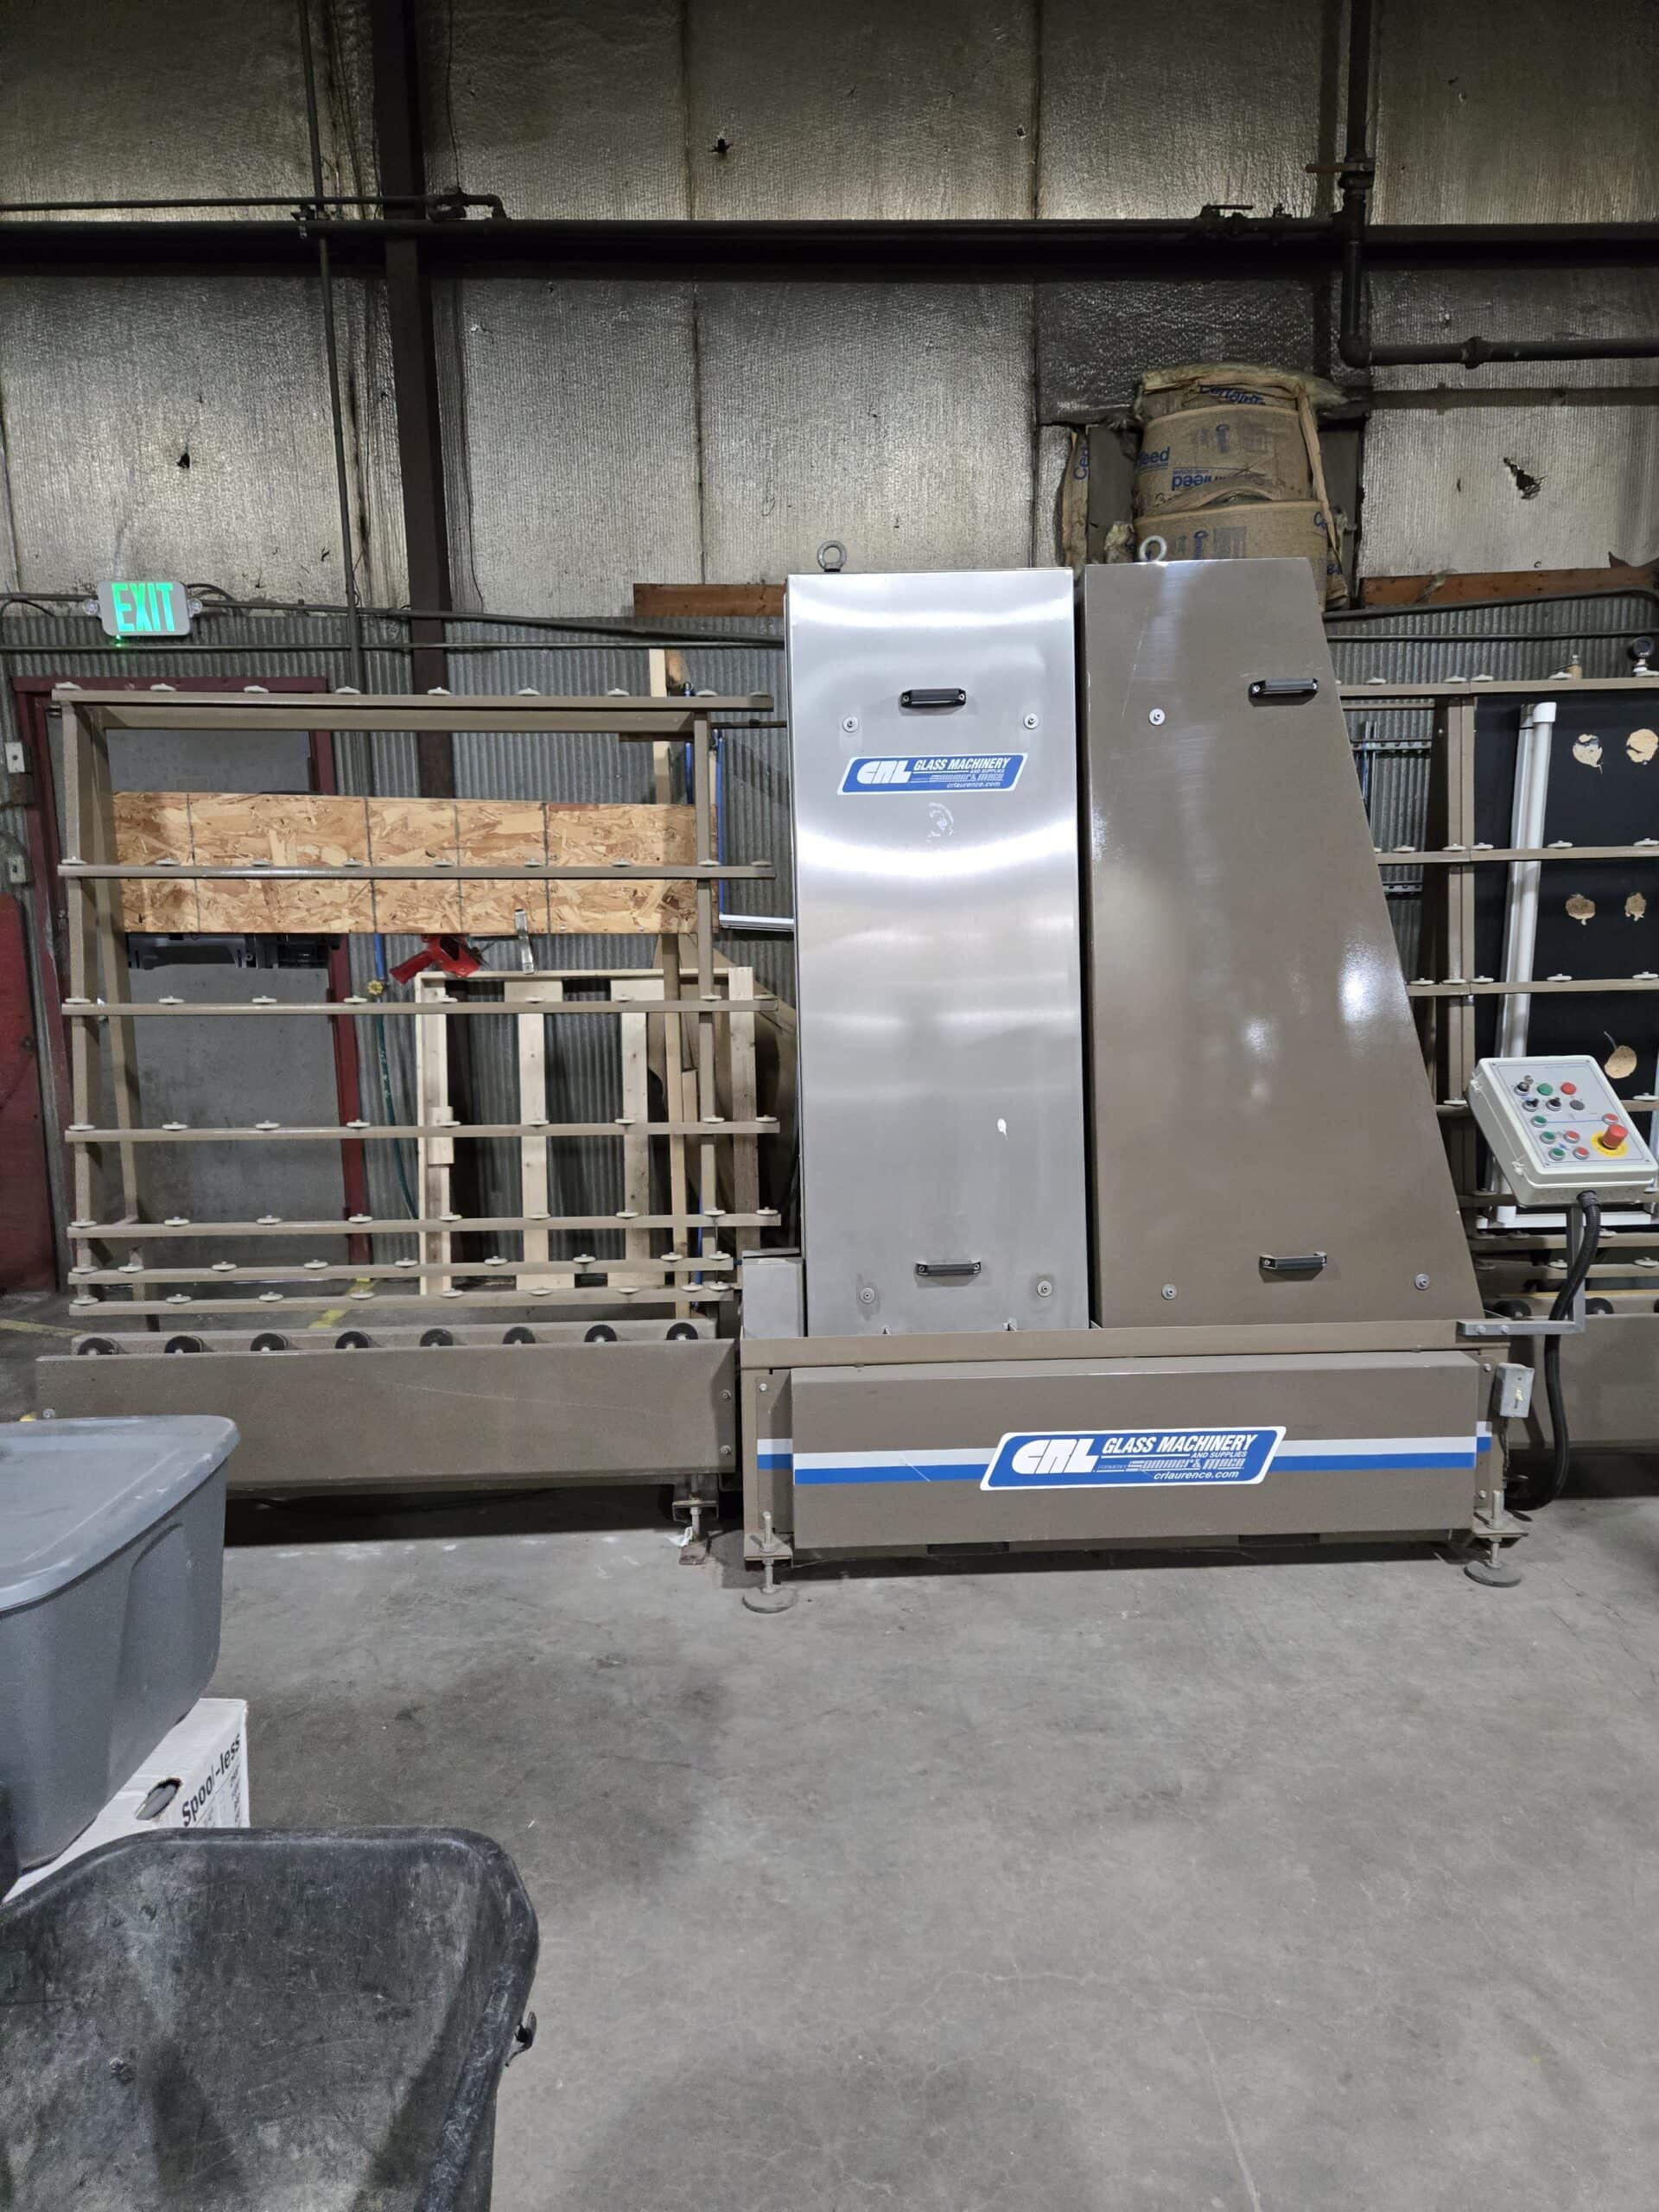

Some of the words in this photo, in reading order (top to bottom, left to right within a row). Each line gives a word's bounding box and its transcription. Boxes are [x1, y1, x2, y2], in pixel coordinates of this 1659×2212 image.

[111, 582, 175, 632] EXIT
[856, 760, 912, 785] CRL
[913, 759, 948, 771] GLASS
[948, 757, 1011, 770] MACHINERY
[1103, 1436, 1156, 1453] GLASS
[1158, 1434, 1258, 1452] MACHINERY
[1012, 1439, 1099, 1474] CRL
[1153, 1470, 1240, 1480] crlaurence.com
[181, 1732, 241, 1827] Spool-less
